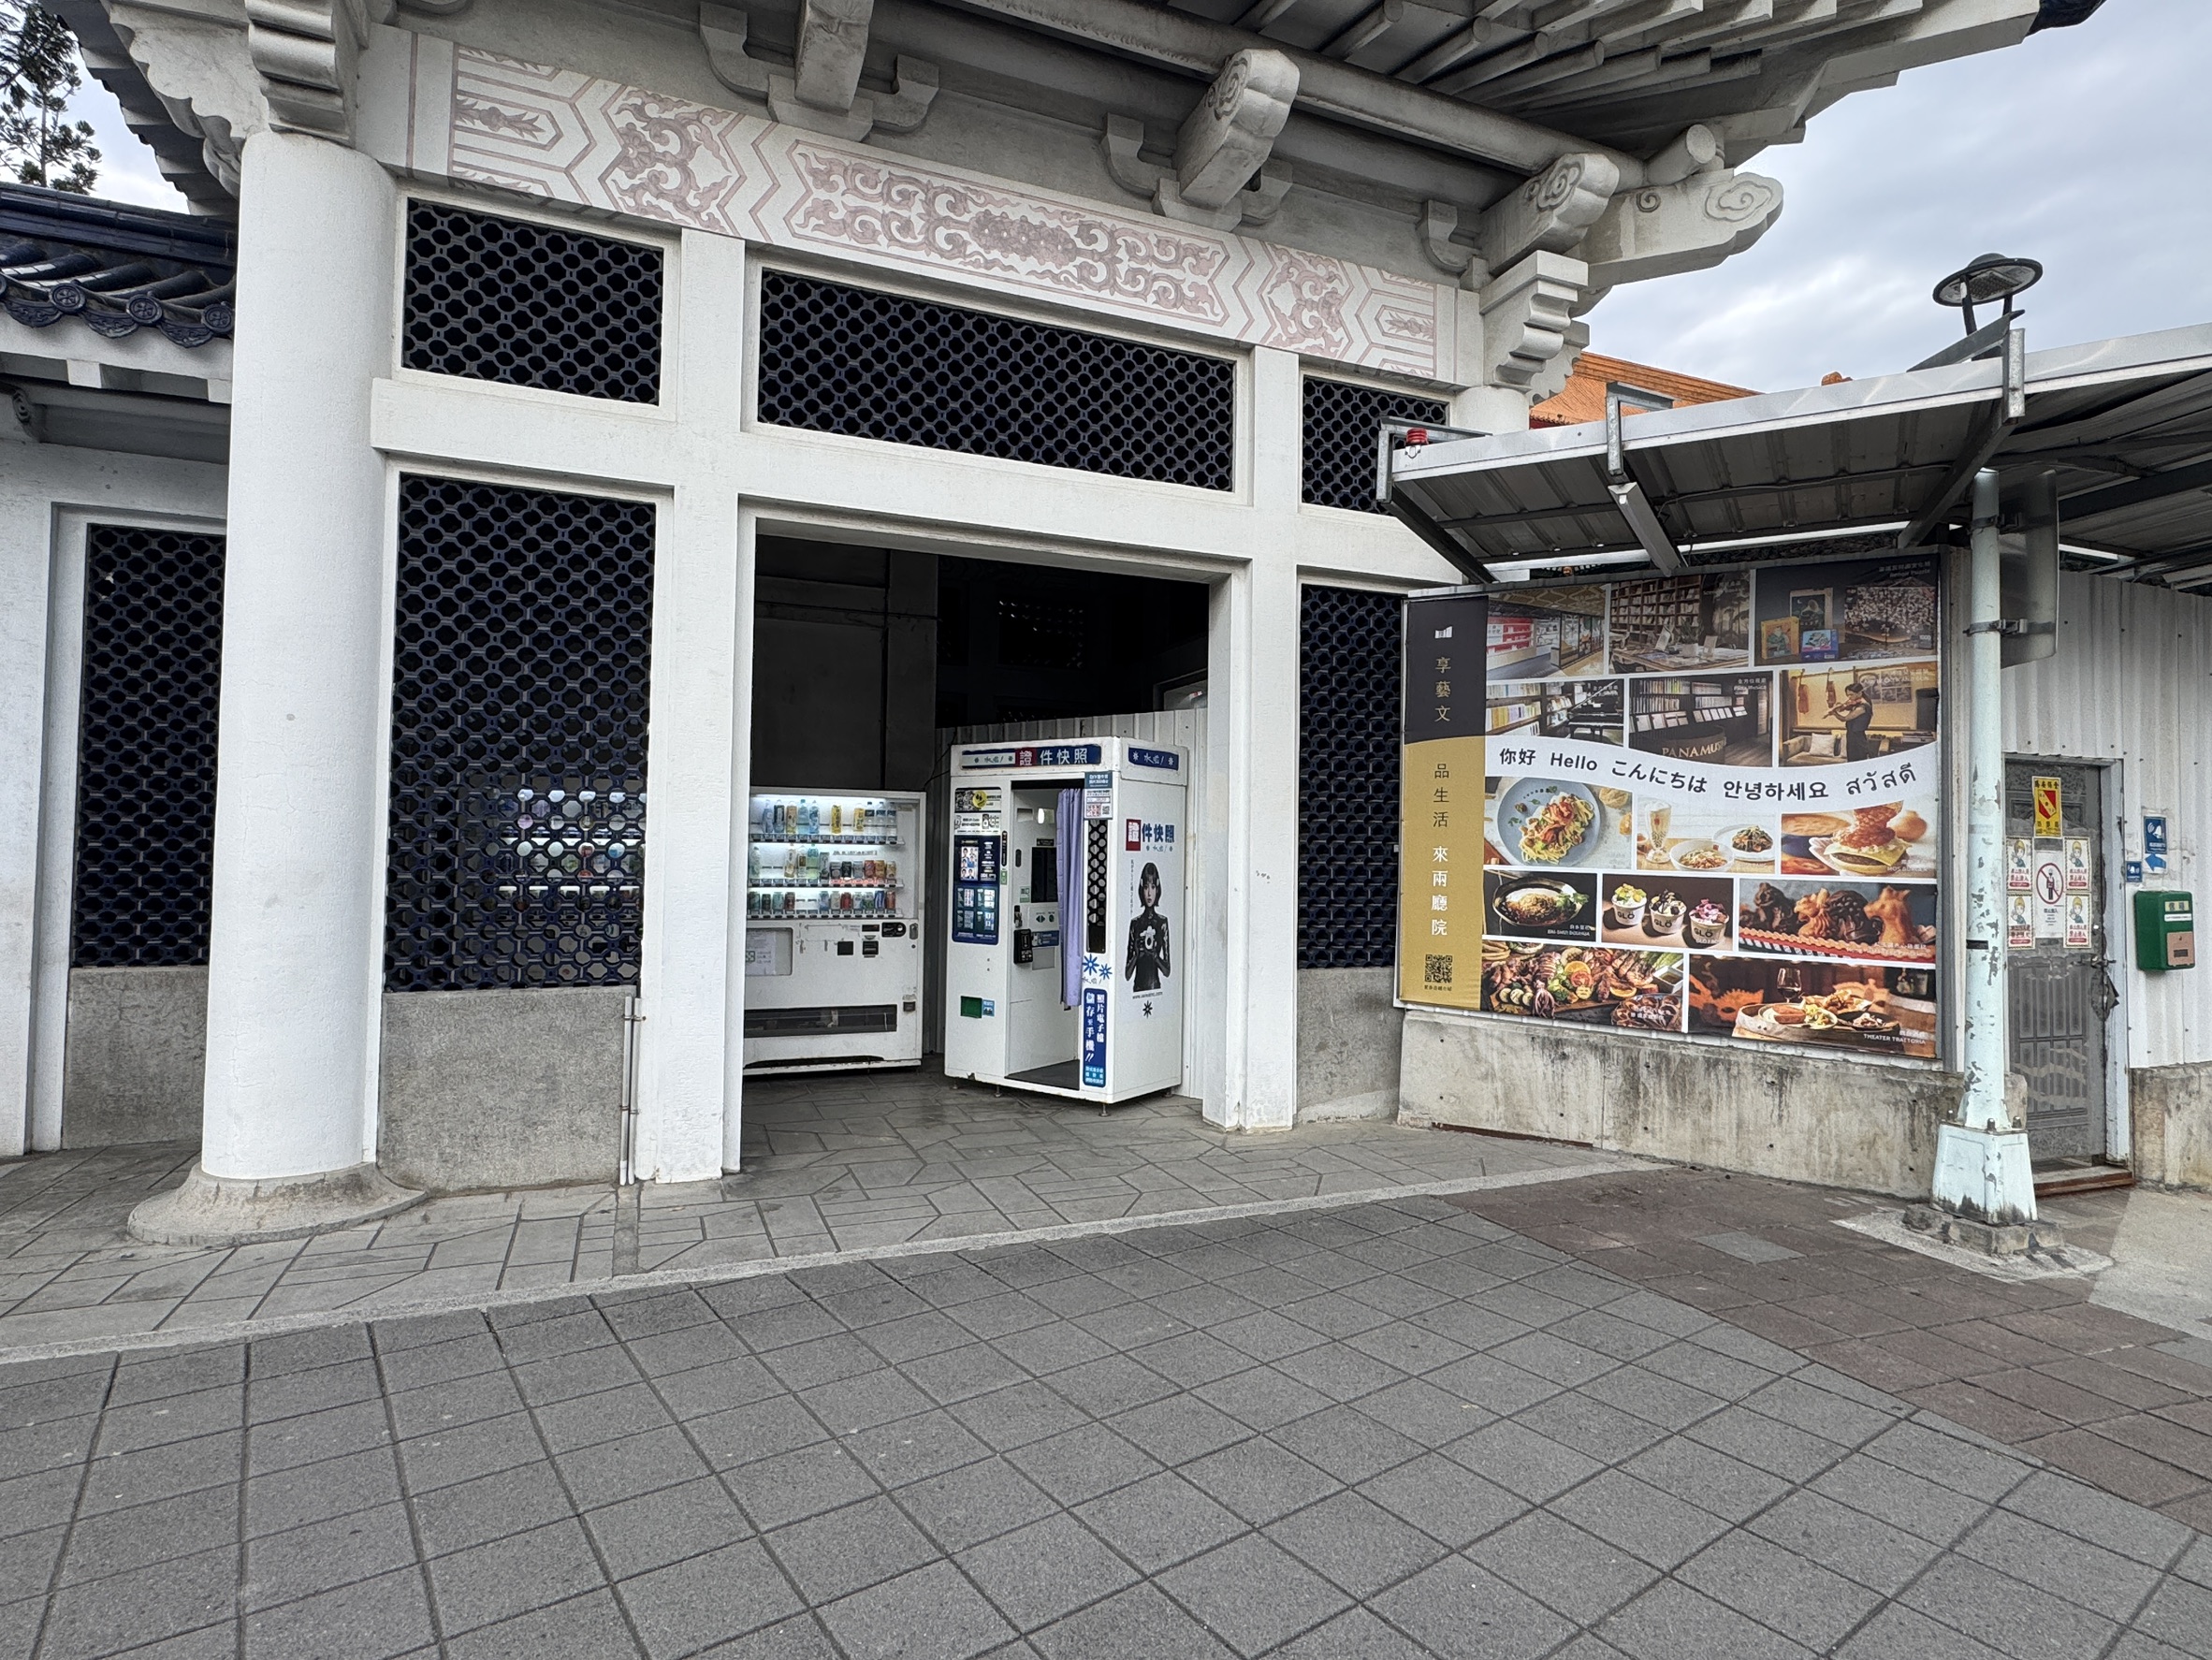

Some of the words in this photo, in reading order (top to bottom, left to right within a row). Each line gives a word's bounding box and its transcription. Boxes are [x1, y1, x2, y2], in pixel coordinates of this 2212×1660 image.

[1433, 656, 1452, 722] 享藝文
[1019, 748, 1088, 766] 證件快照
[1499, 748, 1536, 766] 你好
[1550, 752, 1598, 771] Hello
[1611, 760, 1708, 794] こんにちは
[1845, 762, 1916, 795] สวัสดี
[1433, 763, 1450, 828] 品生活
[1723, 780, 1829, 801] 안녕하세요
[1128, 822, 1175, 843] 證件快照
[1431, 845, 1449, 936] 來兩廳院
[1863, 1033, 1891, 1041] THEATER
[1891, 1036, 1927, 1045] TRATTORIA
